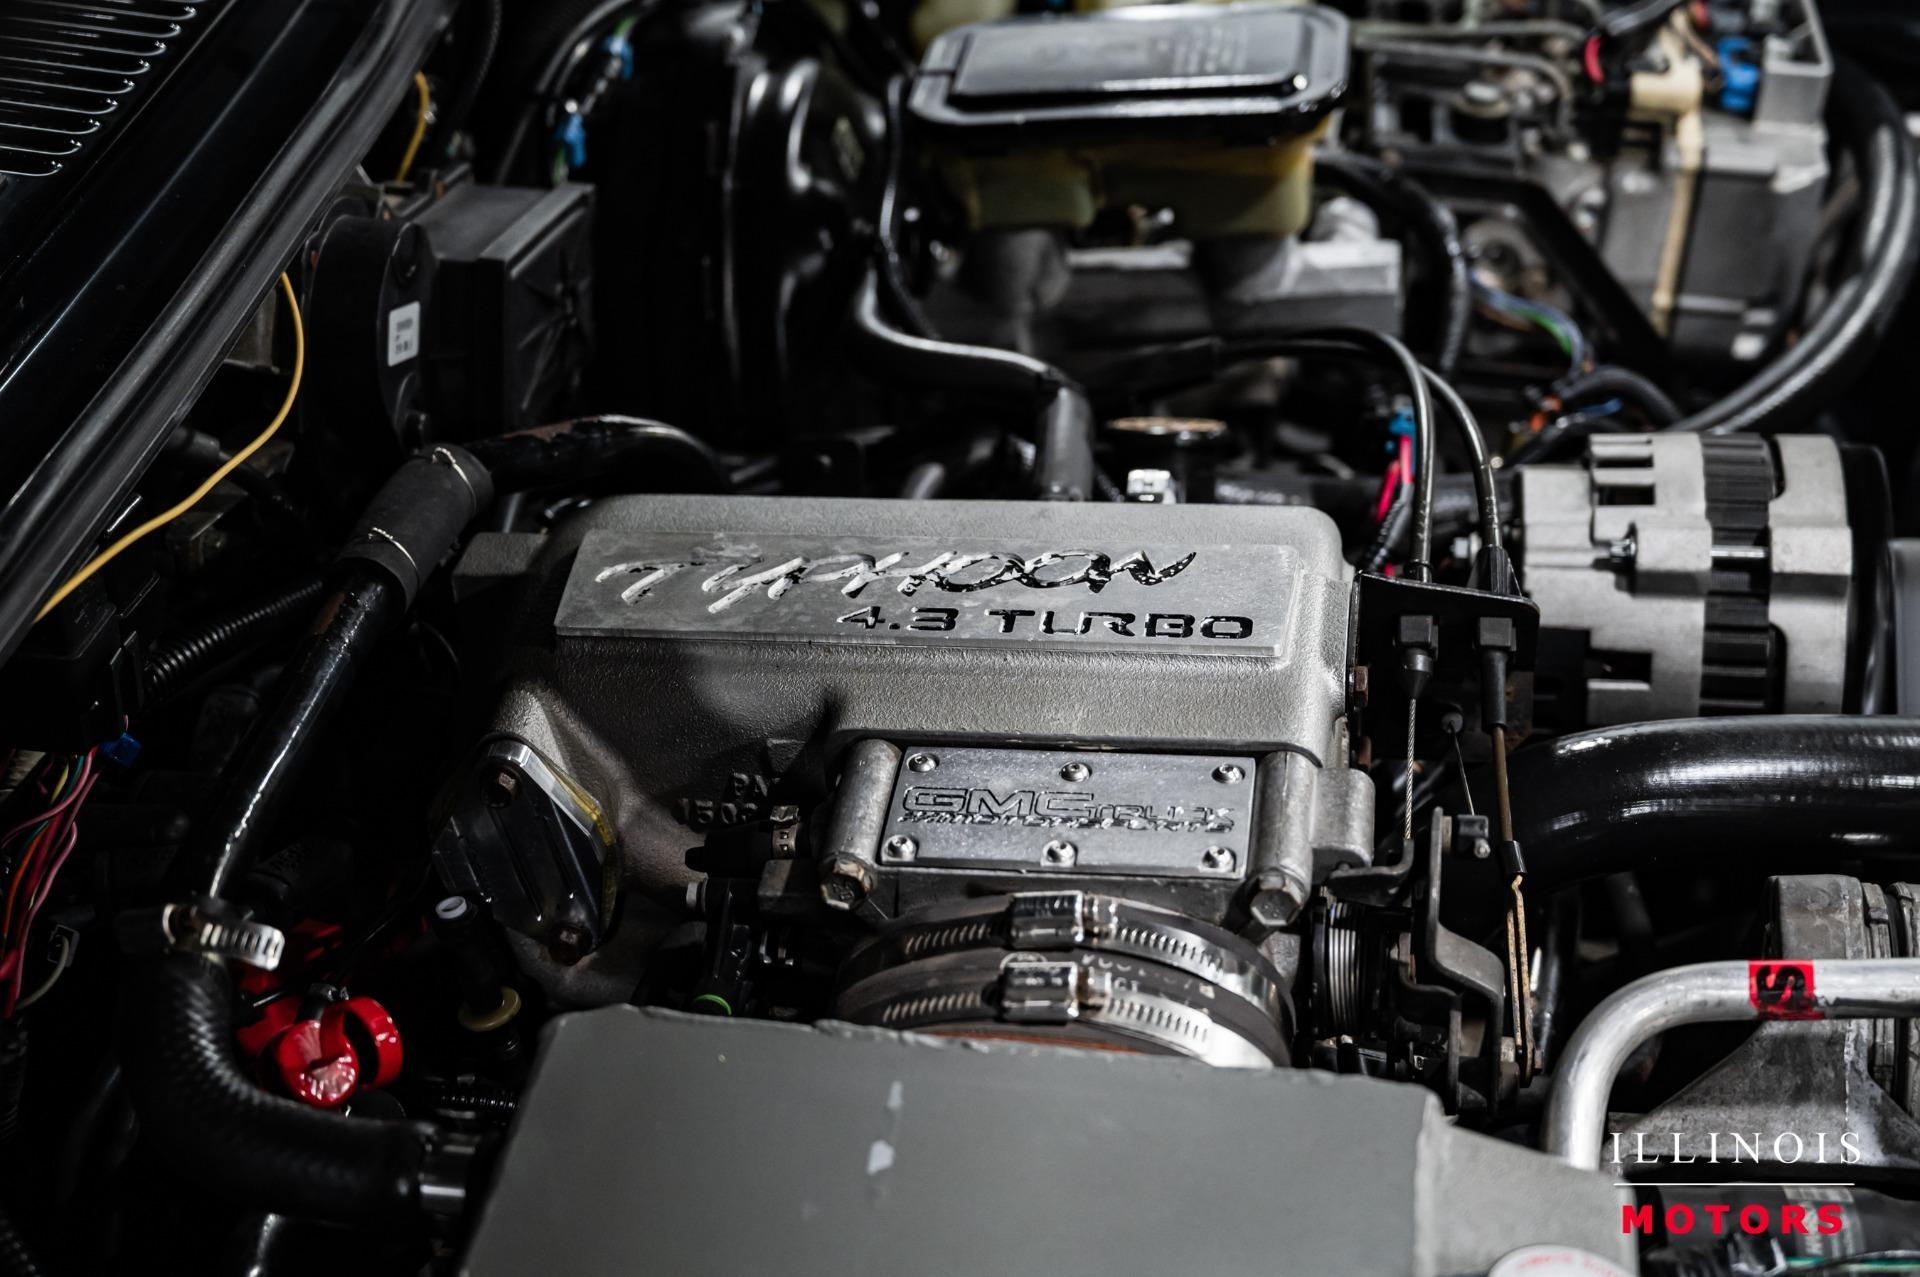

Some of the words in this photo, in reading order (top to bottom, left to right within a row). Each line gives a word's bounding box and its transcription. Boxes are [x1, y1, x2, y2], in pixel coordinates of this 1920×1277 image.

[837, 605, 959, 631] 4.3
[985, 610, 1254, 639] TURBO
[902, 786, 1094, 818] GMC
